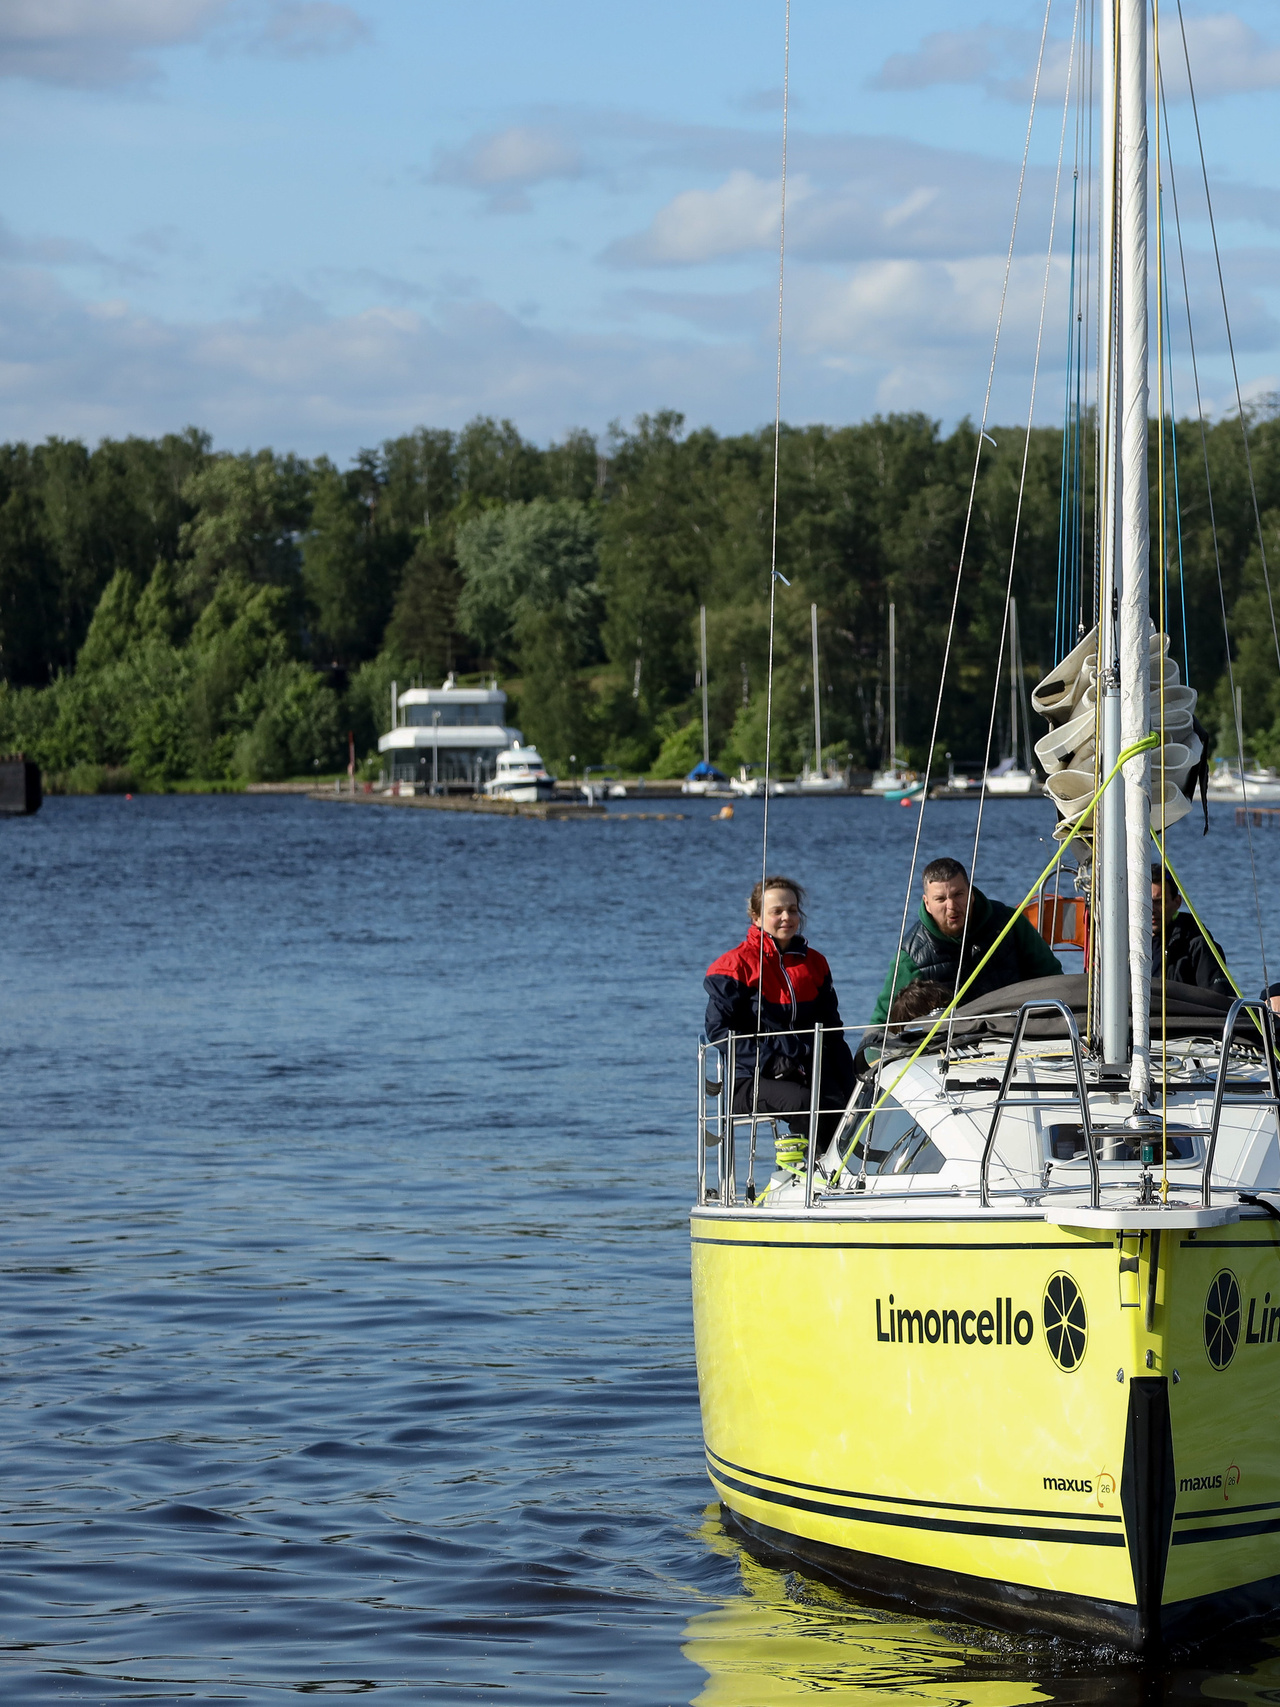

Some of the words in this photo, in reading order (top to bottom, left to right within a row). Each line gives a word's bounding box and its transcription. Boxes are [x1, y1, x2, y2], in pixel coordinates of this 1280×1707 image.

[876, 1294, 1034, 1345] Limoncello
[1043, 1476, 1093, 1493] maxus
[1100, 1484, 1111, 1494] 26
[1179, 1474, 1222, 1492] maxus
[1227, 1476, 1237, 1487] 26
